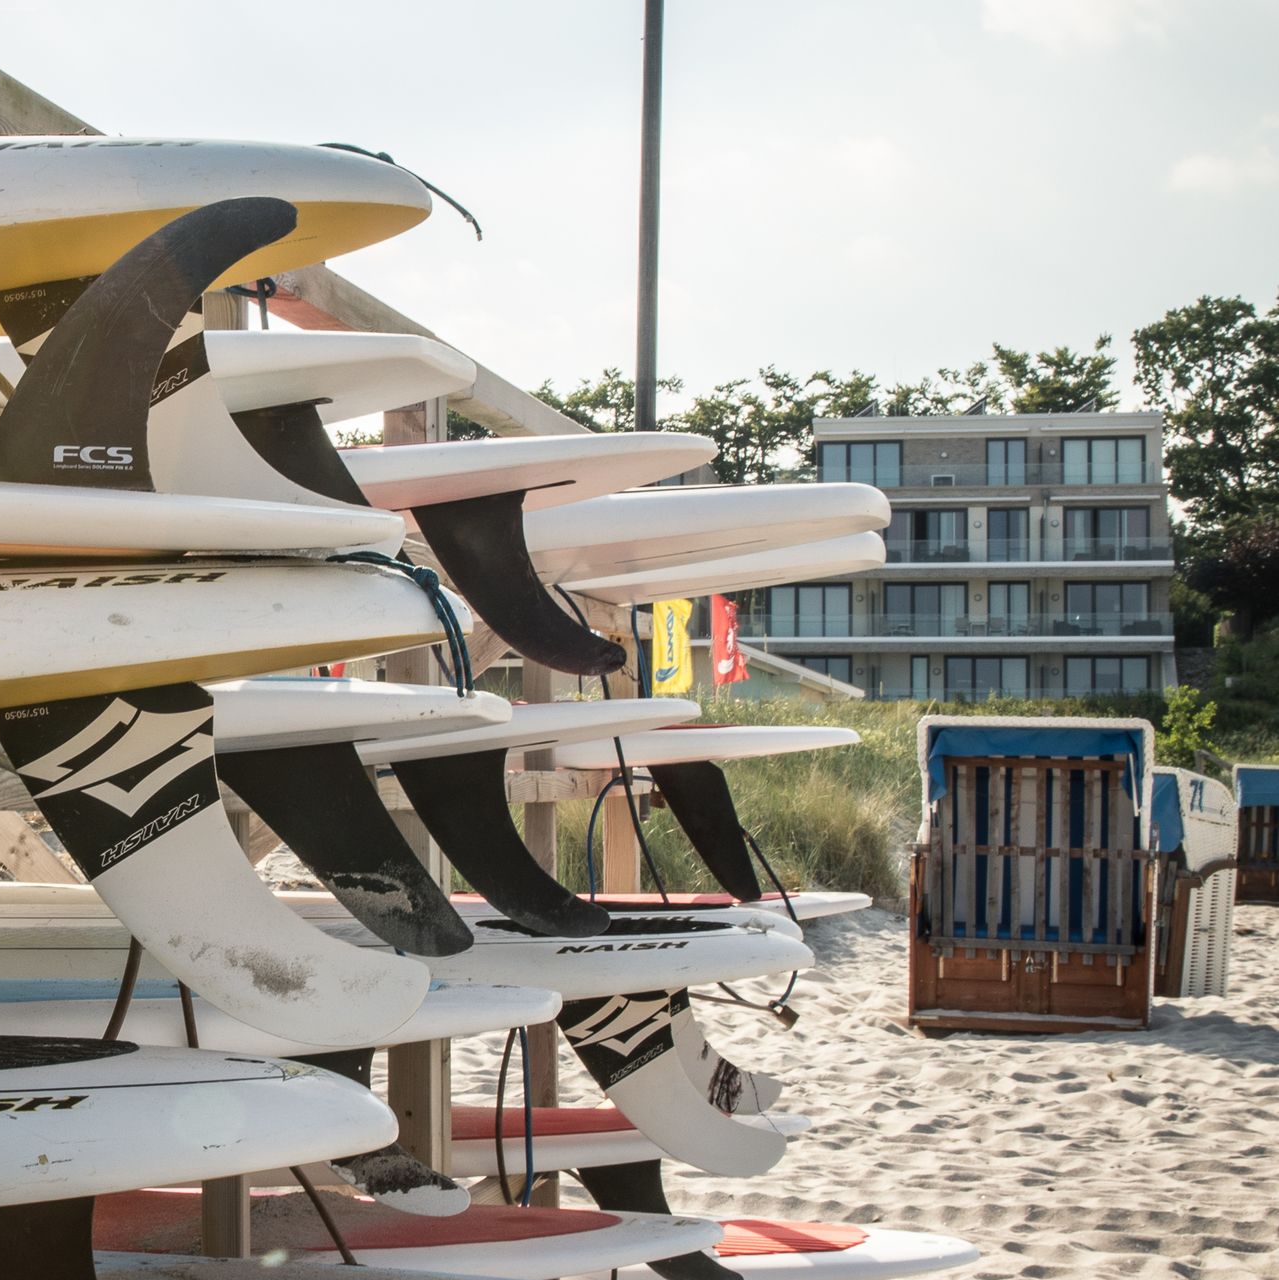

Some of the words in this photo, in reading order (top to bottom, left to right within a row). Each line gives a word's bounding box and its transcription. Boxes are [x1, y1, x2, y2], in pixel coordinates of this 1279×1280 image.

[53, 445, 134, 464] FCS
[1189, 779, 1204, 813] 71
[100, 793, 200, 868] NAISH
[556, 941, 690, 954] NAISH
[608, 1042, 665, 1084] NAISH
